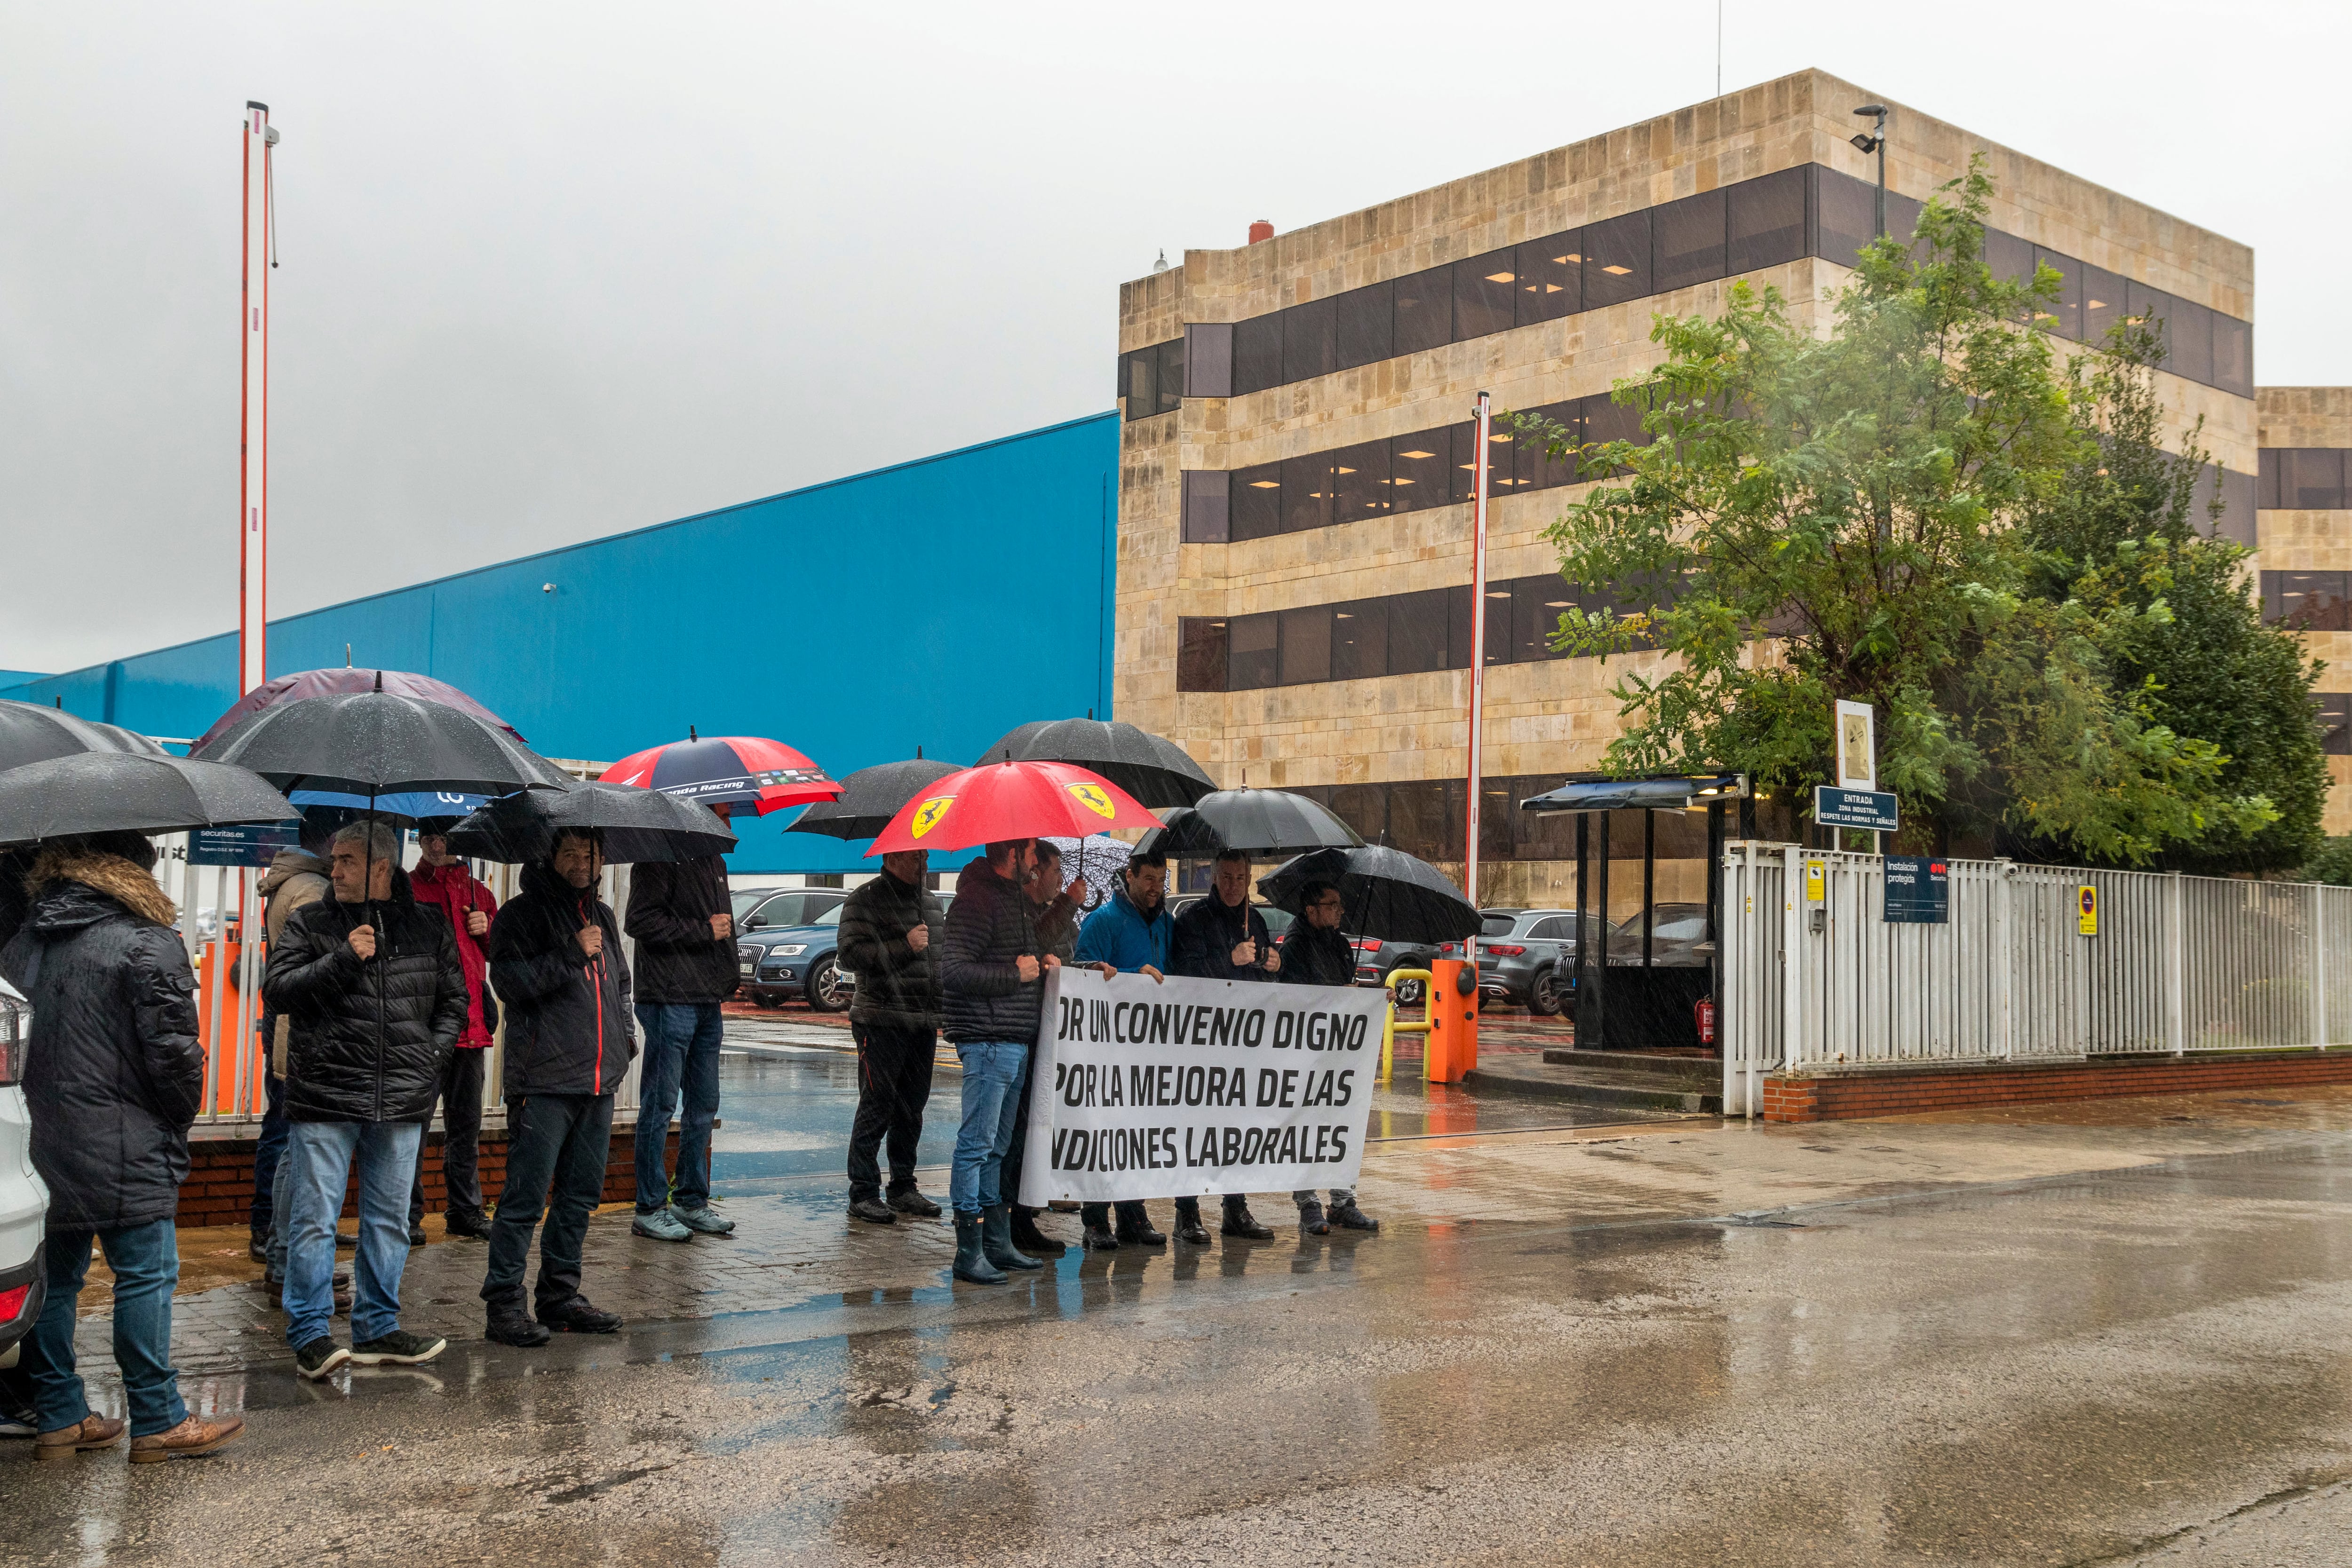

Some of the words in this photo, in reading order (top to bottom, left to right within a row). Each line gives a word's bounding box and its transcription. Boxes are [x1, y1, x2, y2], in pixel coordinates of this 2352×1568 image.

[700, 781, 745, 792] Racing
[1844, 794, 1873, 805] ENTRADA
[1876, 817, 1896, 825] SEÑALES
[200, 830, 244, 838] securitas.es
[1888, 861, 1918, 871] Instalación
[1888, 874, 1915, 885] protegida
[1090, 999, 1110, 1043] UN
[1114, 1002, 1265, 1048] CONVENIO
[1272, 1010, 1368, 1051] DIGNO
[1102, 1065, 1124, 1107] LA
[1130, 1065, 1246, 1107] MEJORA
[1256, 1068, 1299, 1108] DE
[1302, 1069, 1355, 1107] LAS
[1186, 1125, 1349, 1167] LABORALES
